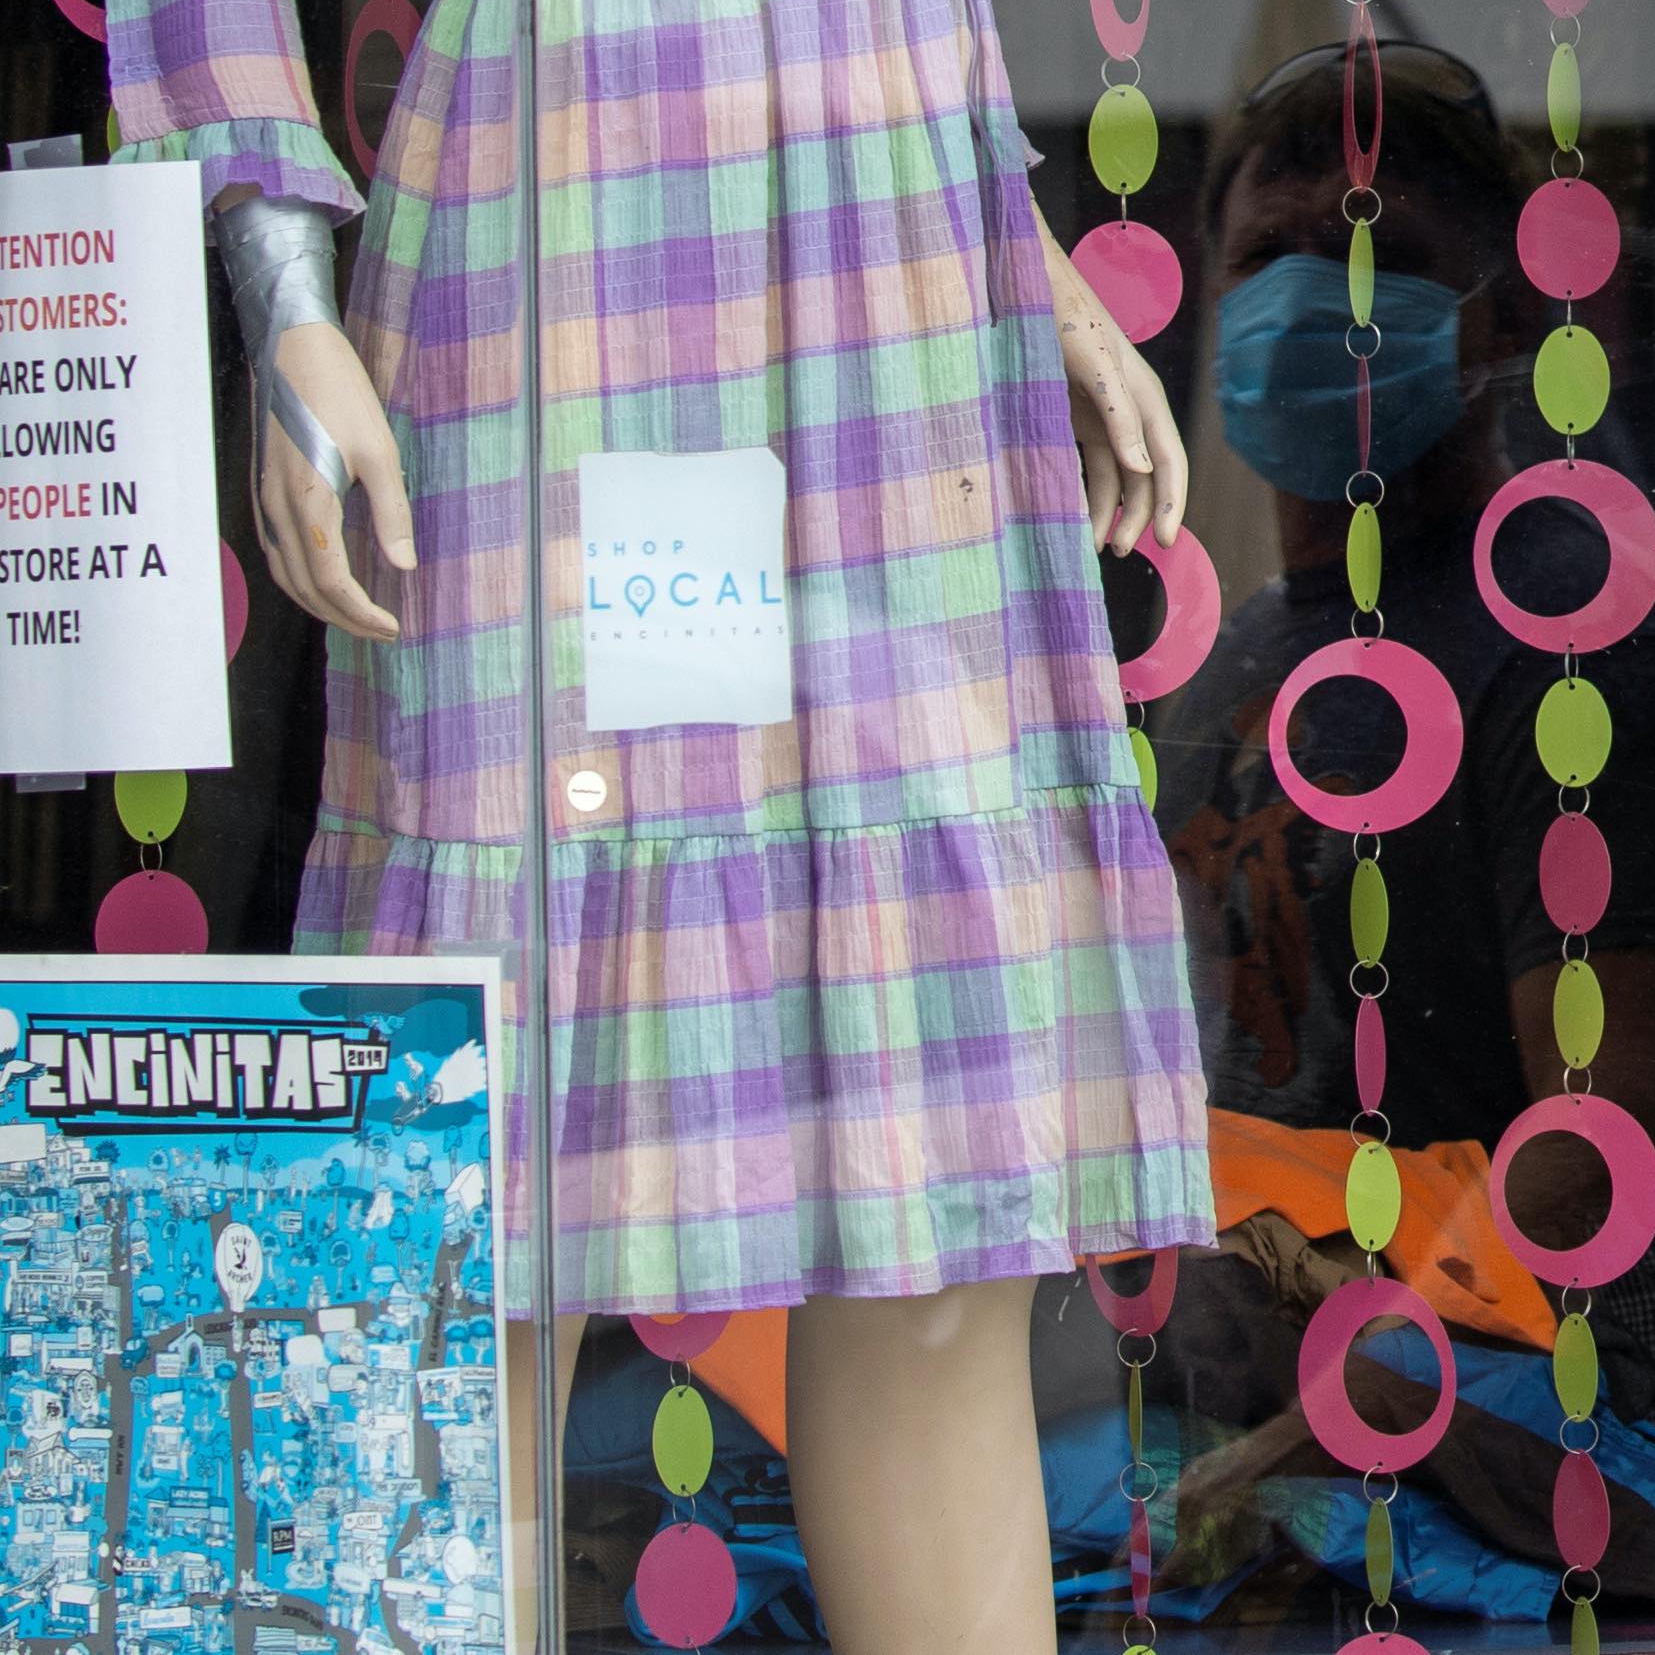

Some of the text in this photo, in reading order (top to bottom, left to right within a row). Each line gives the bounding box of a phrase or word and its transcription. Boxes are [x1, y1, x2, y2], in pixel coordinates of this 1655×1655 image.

[0, 354, 137, 395] ARE ONLY
[102, 480, 137, 516] IN
[0, 542, 168, 584] STORE AT A
[587, 540, 685, 558] SHOP
[588, 570, 783, 618] LOCAL
[7, 609, 81, 647] TIME!
[590, 625, 785, 642] ENCINITAS
